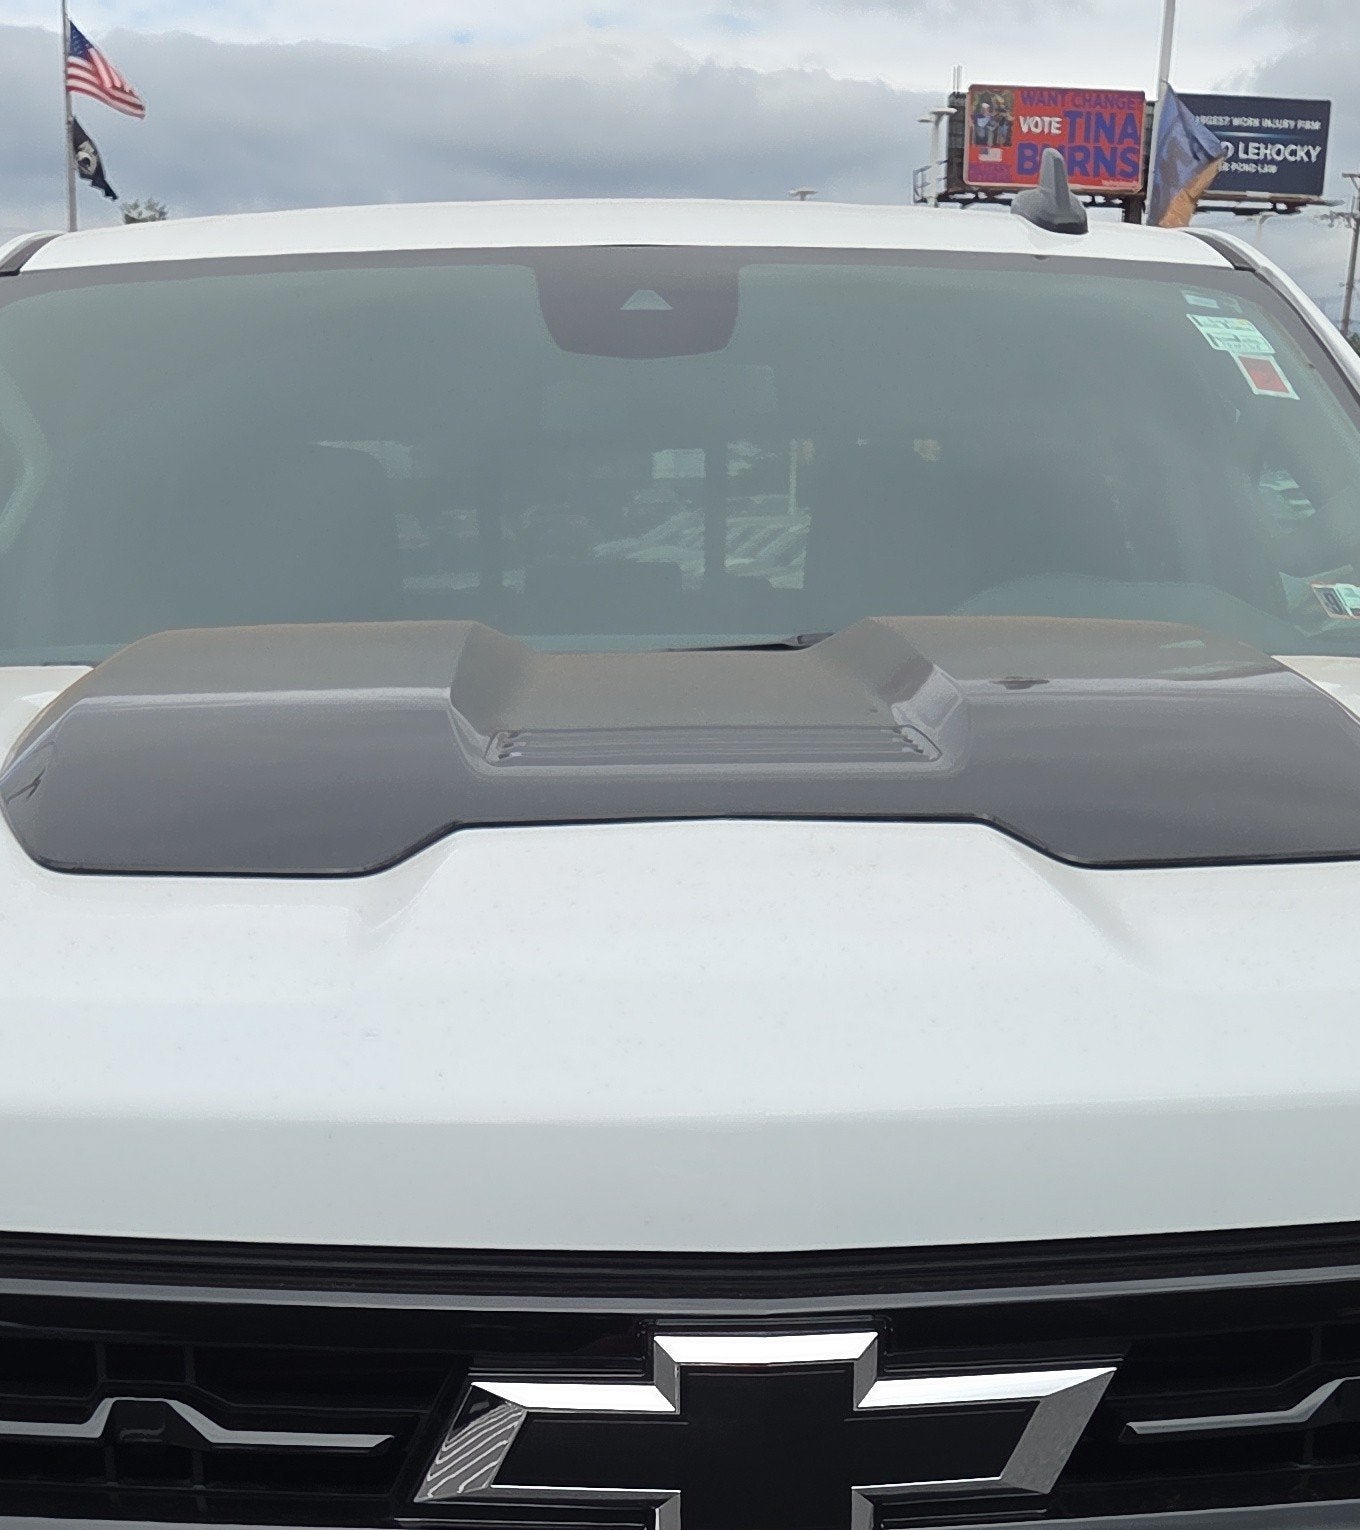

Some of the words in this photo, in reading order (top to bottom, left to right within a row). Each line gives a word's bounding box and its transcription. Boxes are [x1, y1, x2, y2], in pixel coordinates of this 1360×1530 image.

[1019, 115, 1062, 134] VOTE
[1063, 110, 1140, 145] TINA
[1016, 142, 1140, 179] BRNS
[1238, 141, 1322, 163] LEHOCKY
